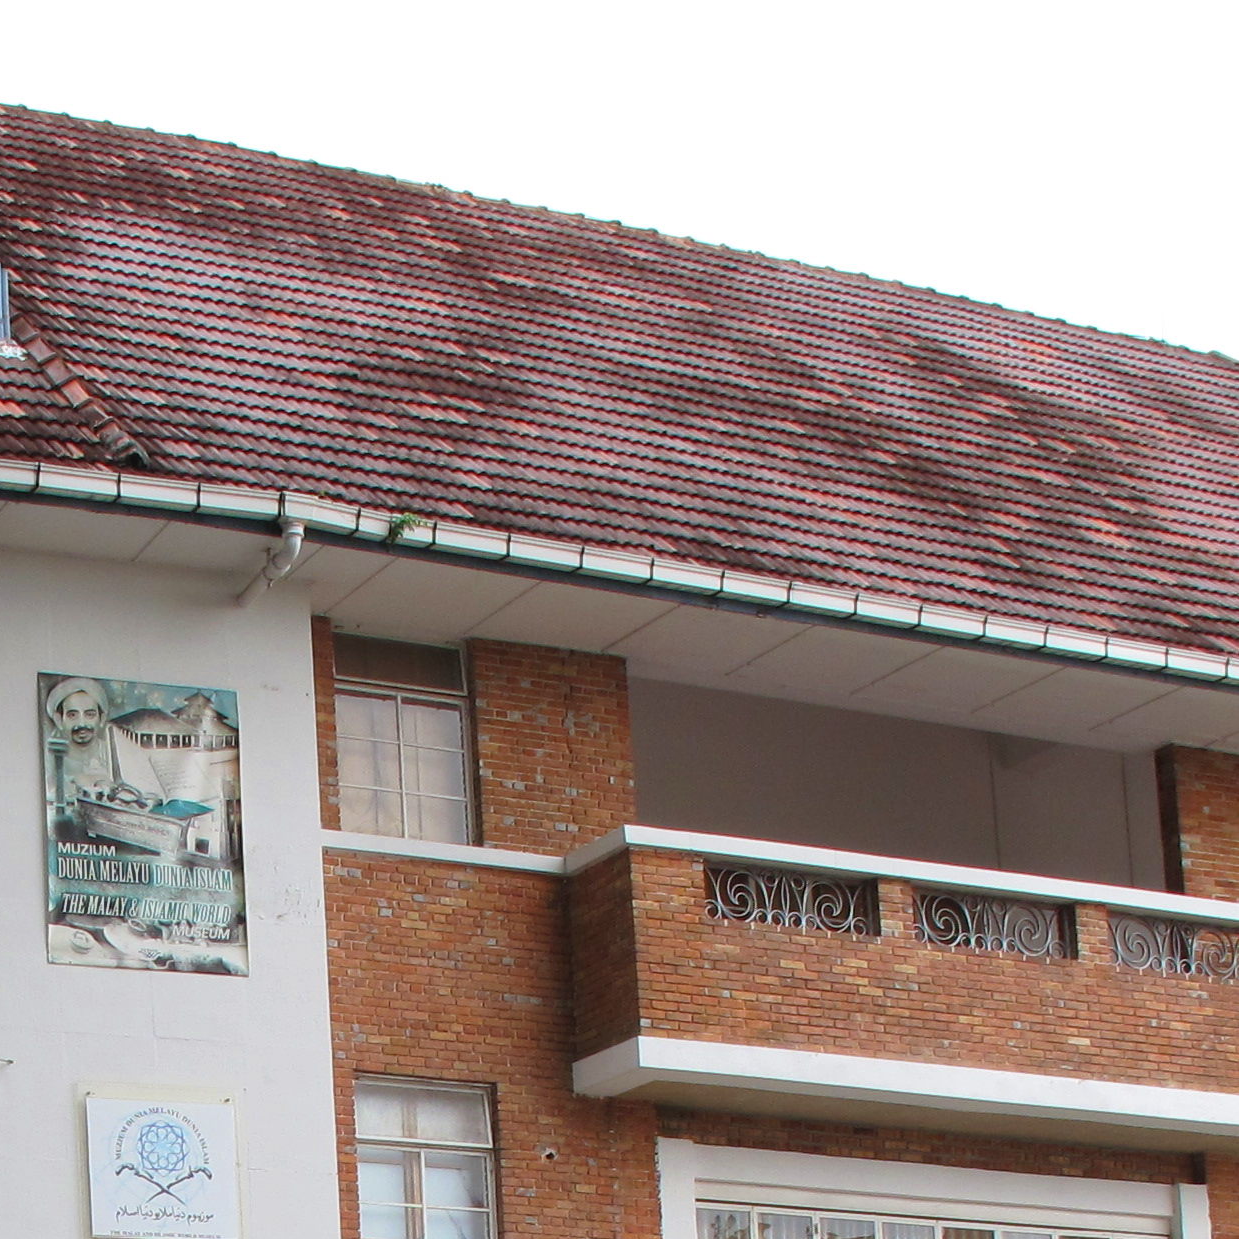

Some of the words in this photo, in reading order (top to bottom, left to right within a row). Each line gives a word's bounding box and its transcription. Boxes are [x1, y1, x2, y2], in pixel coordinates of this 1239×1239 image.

[58, 842, 116, 857] MUZIUM
[58, 857, 98, 881] DUNIA
[100, 860, 150, 885] MELAYU
[153, 864, 194, 889] DUNIA
[195, 868, 233, 892] ISLAM
[62, 893, 87, 913] THE
[87, 894, 128, 916] MALAY
[129, 899, 139, 917] &
[140, 899, 190, 922] ISLAMIC
[191, 902, 232, 924] WORLD
[172, 924, 230, 940] MUSEUM
[115, 1126, 128, 1160] MUZIUM
[126, 1111, 148, 1127] DUNIA
[148, 1107, 180, 1119] MELAYU
[181, 1116, 202, 1138] DUNIA
[199, 1138, 209, 1164] ISLAM
